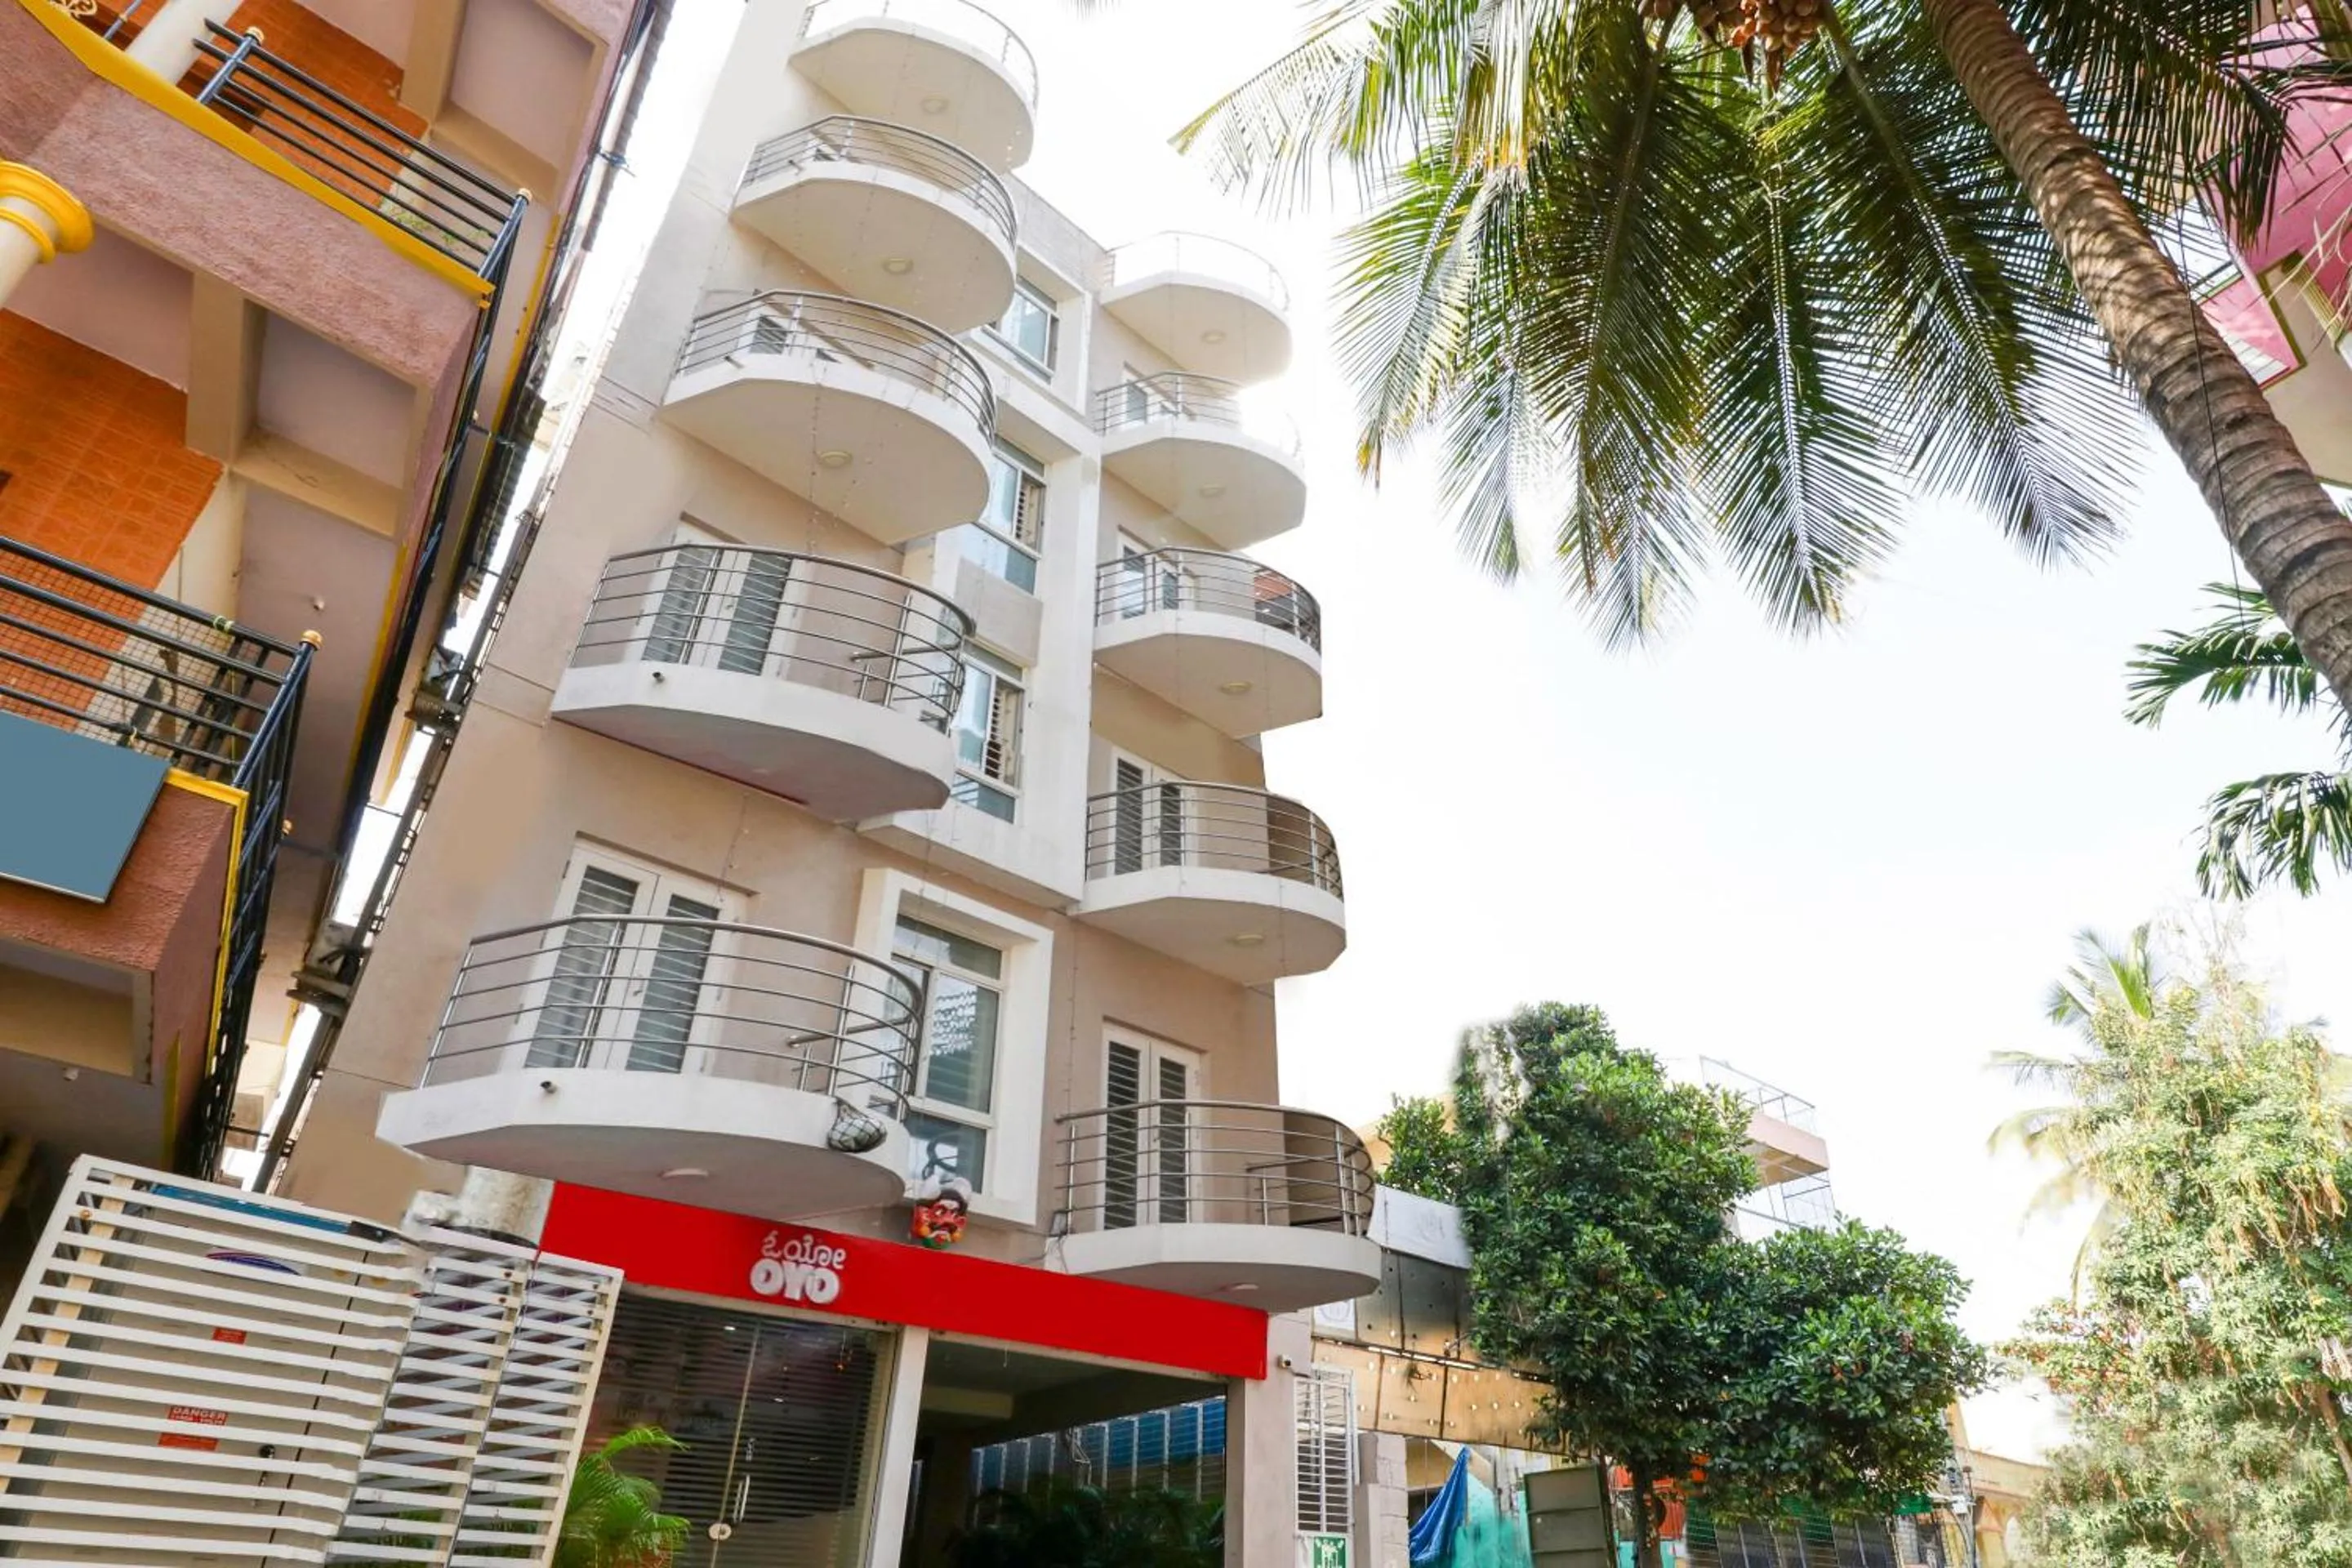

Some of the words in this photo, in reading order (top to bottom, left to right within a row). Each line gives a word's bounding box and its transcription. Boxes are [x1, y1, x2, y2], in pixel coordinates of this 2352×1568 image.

[762, 1231, 846, 1269] ಓಯೋ
[750, 1258, 840, 1304] OYO
[172, 1406, 225, 1420] DANGER
